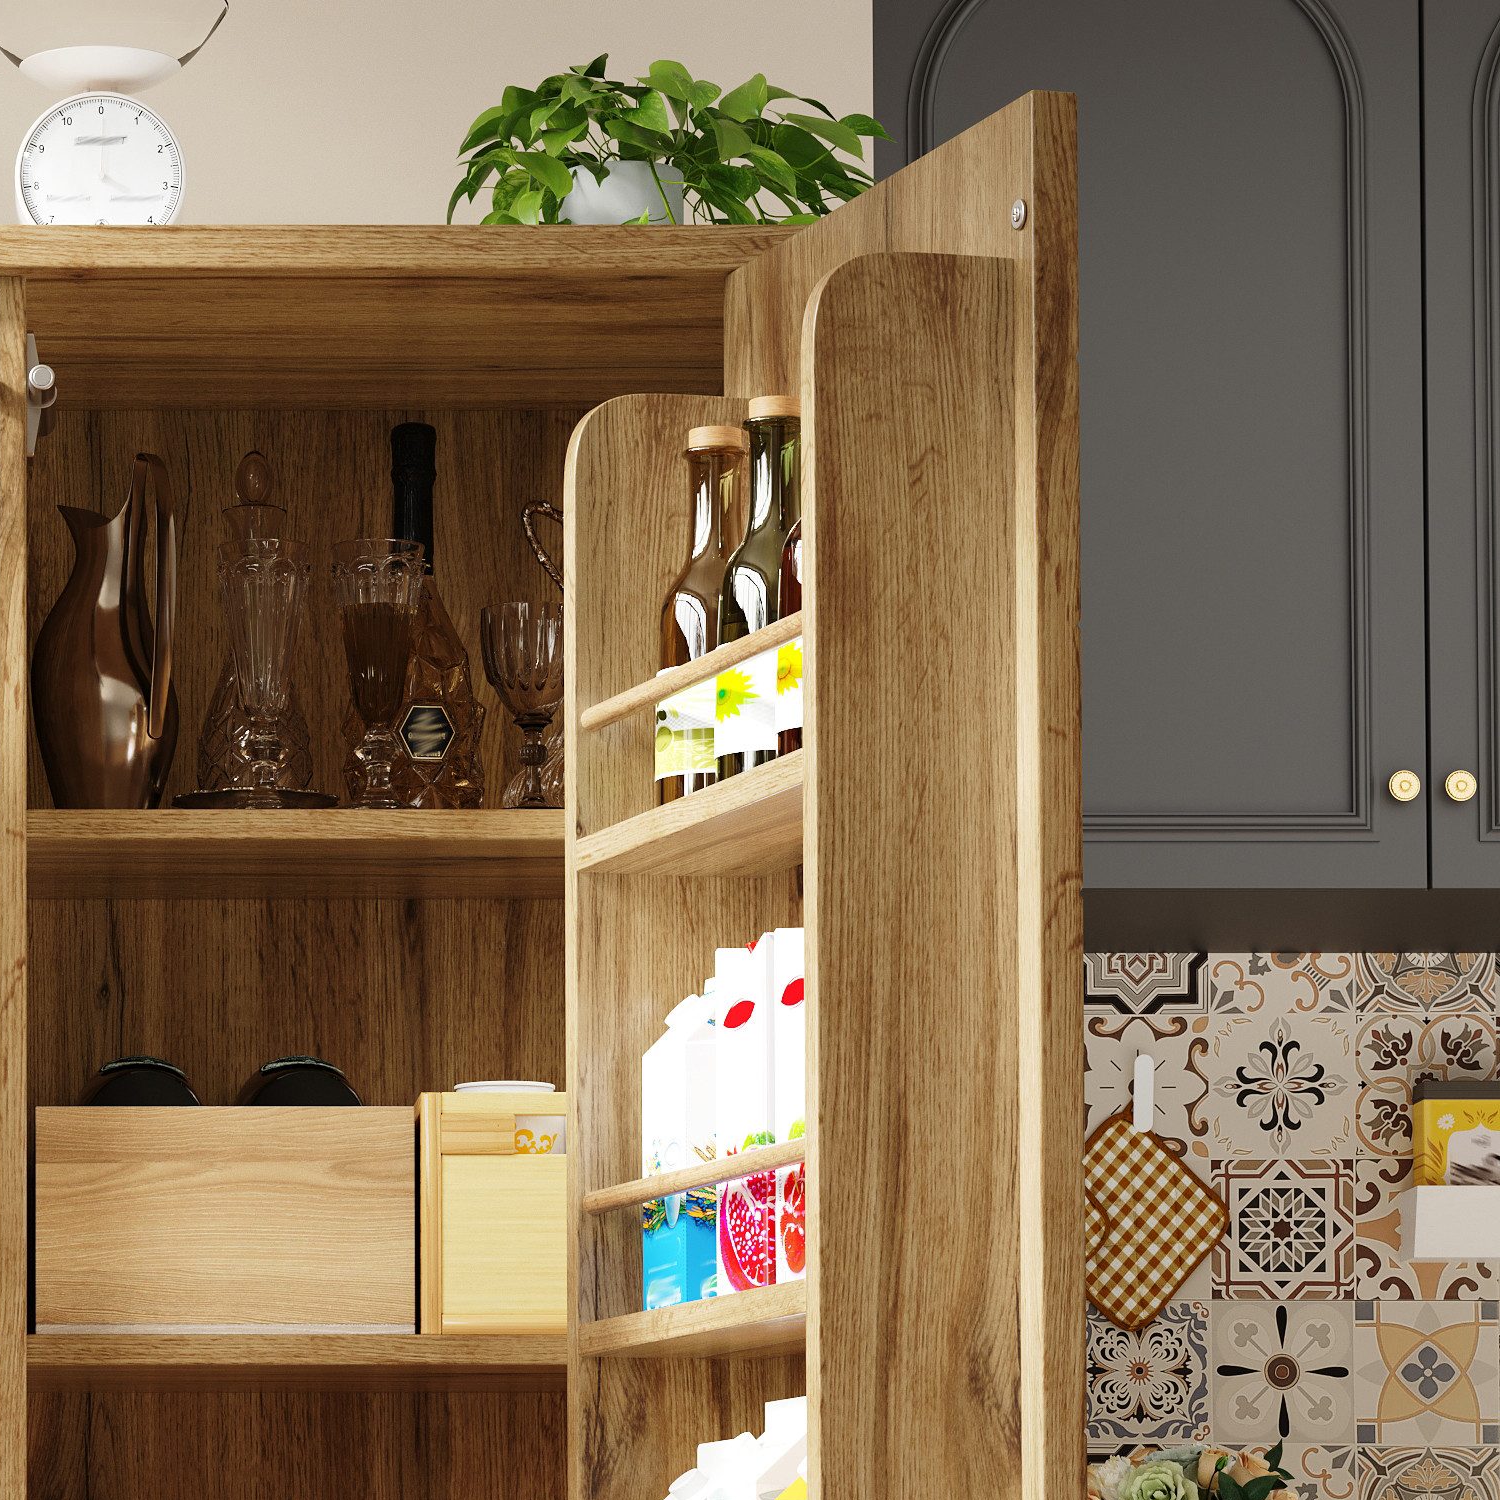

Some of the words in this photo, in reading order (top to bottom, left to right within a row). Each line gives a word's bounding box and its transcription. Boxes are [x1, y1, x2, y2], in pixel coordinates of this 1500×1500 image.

[98, 106, 104, 115] 0
[62, 117, 73, 126] 10
[134, 117, 139, 125] 1
[38, 144, 45, 154] 9
[157, 144, 164, 154] 2
[33, 181, 40, 191] 8
[162, 181, 169, 191] 3
[49, 215, 55, 223] 7
[147, 215, 153, 224] 4
